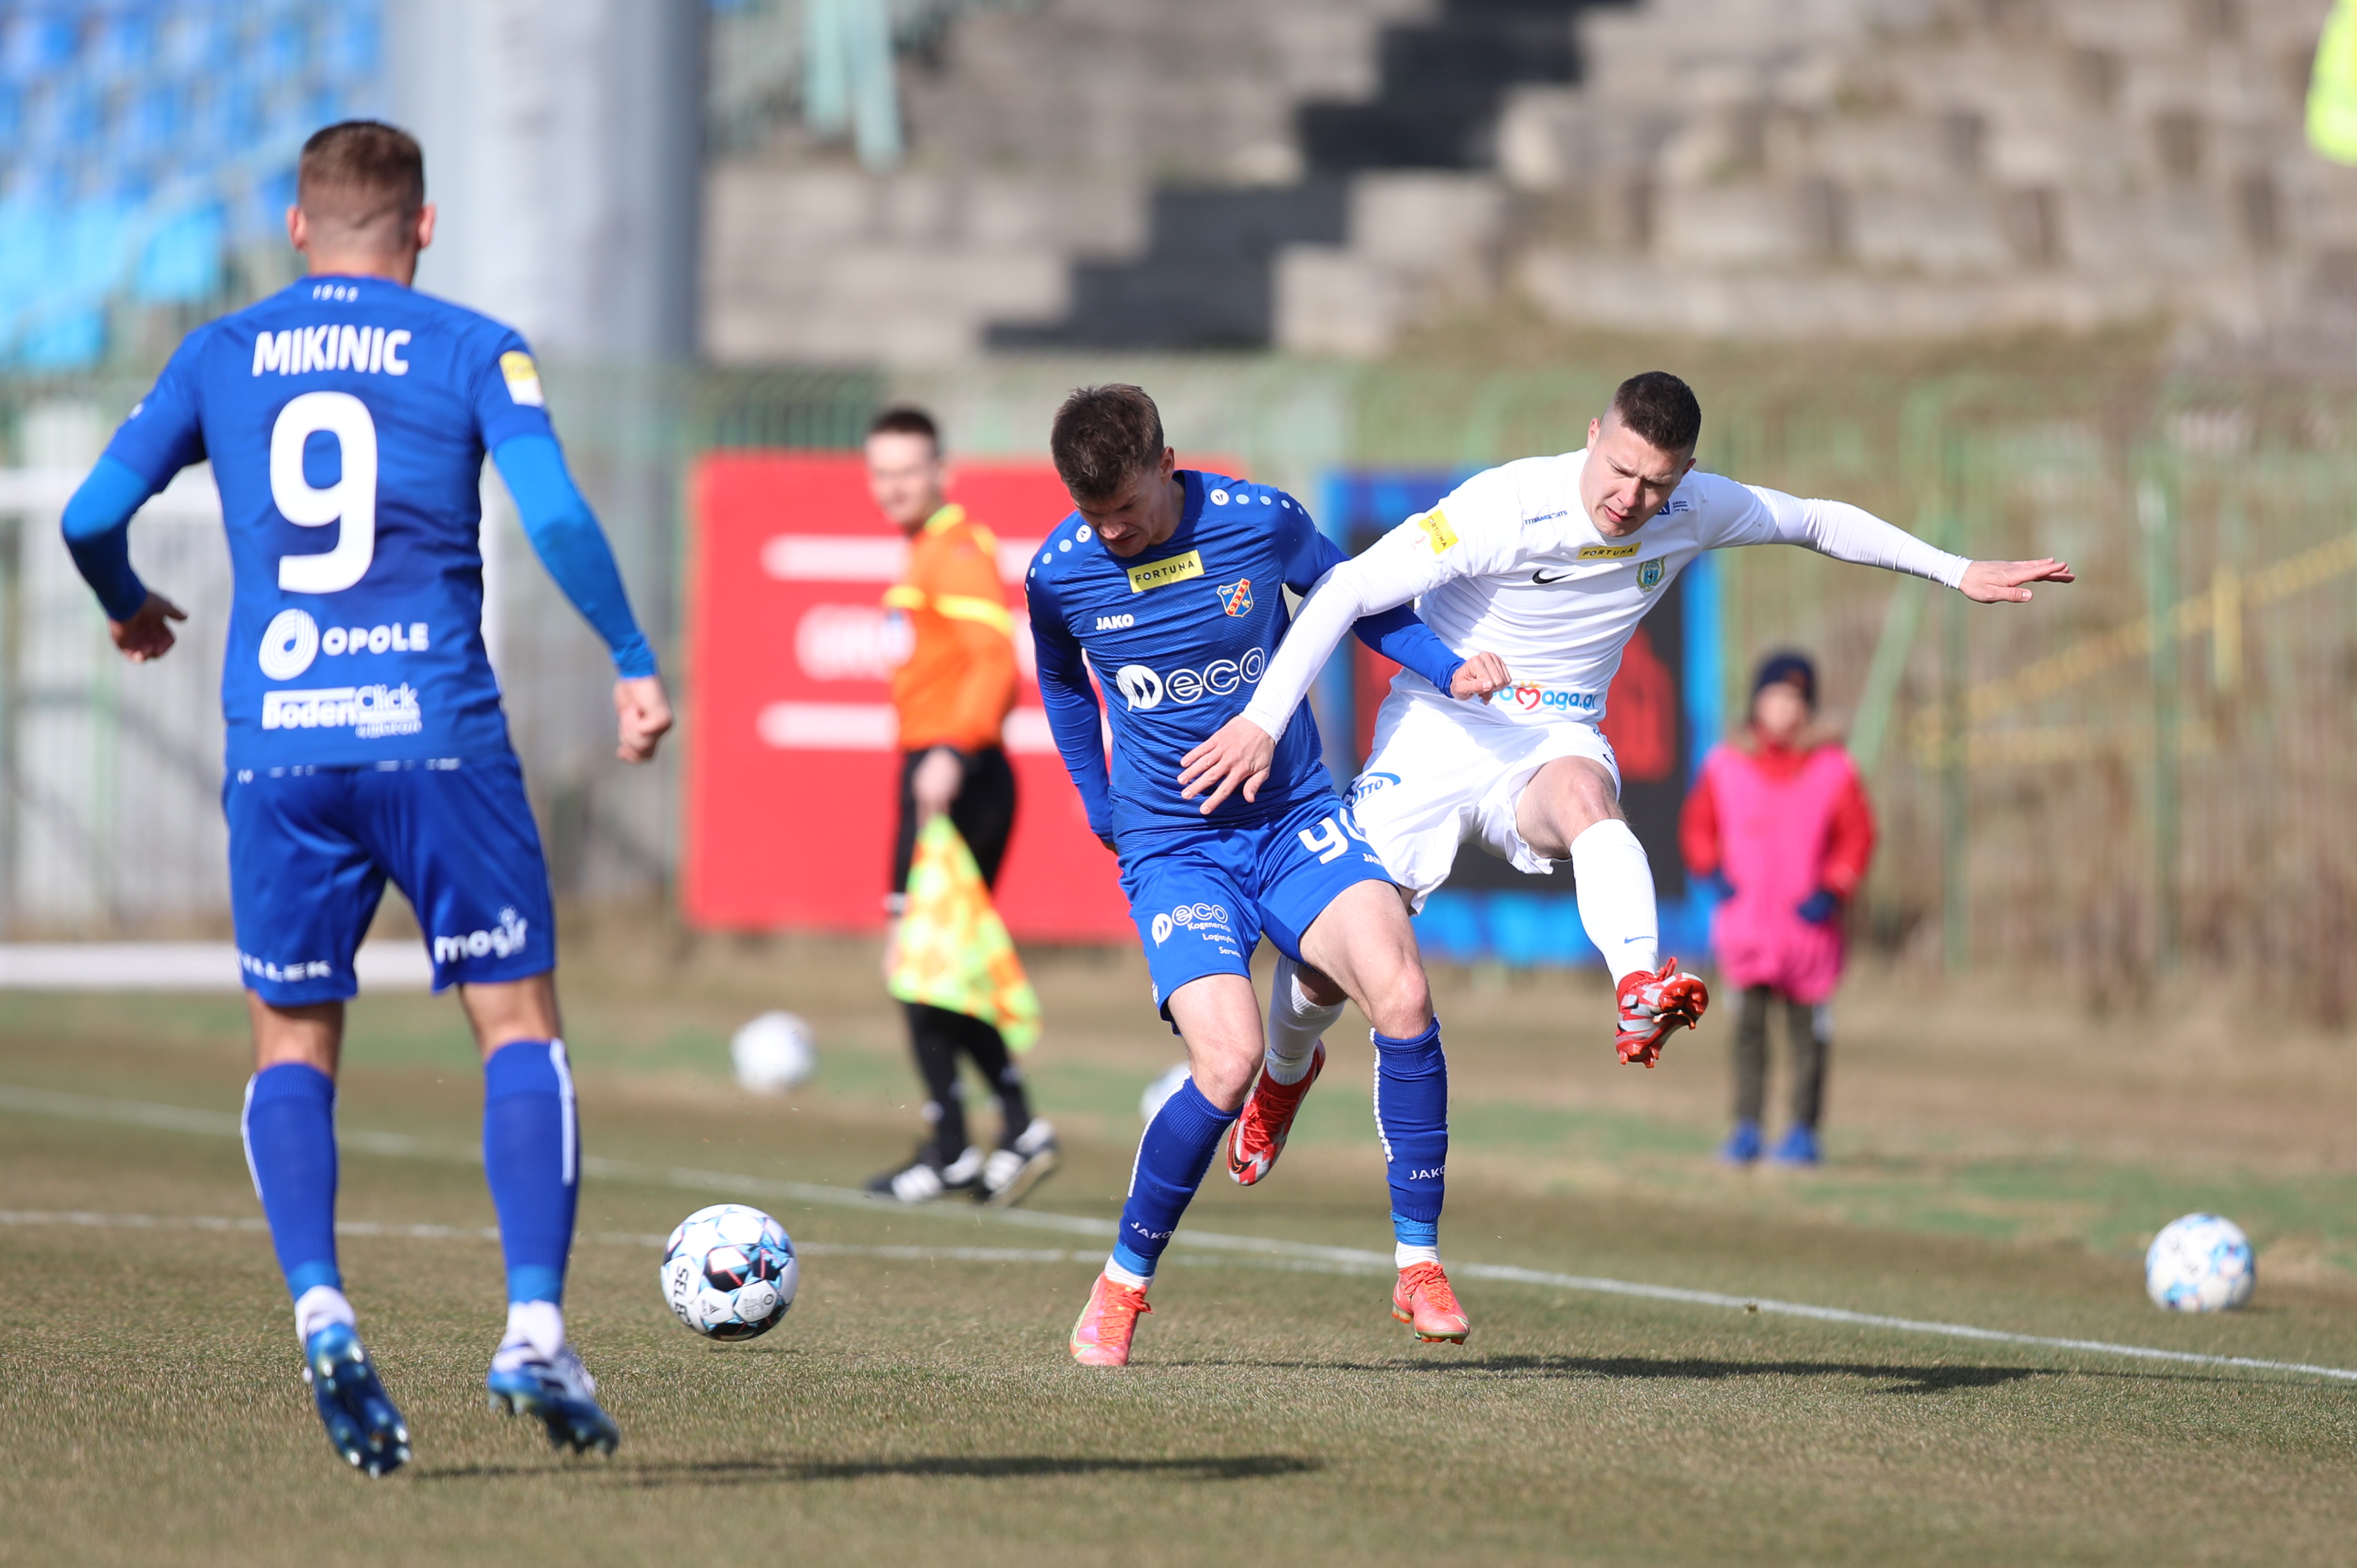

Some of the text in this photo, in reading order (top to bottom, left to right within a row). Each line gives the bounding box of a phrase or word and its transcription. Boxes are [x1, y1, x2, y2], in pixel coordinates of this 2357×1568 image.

[252, 324, 412, 377] MIKINIC
[269, 390, 378, 595] 9
[1428, 515, 1447, 547] FORTUNA
[1582, 547, 1634, 556] FORTUNA
[1135, 560, 1195, 583] FORTUNA
[1229, 584, 1248, 612] ODRA
[1096, 614, 1134, 630] JAKO
[321, 622, 429, 655] OPOLE
[1165, 647, 1266, 705] eco
[1171, 902, 1228, 926] eco
[1218, 946, 1241, 958] Serwis
[1130, 1222, 1173, 1240] JAKO
